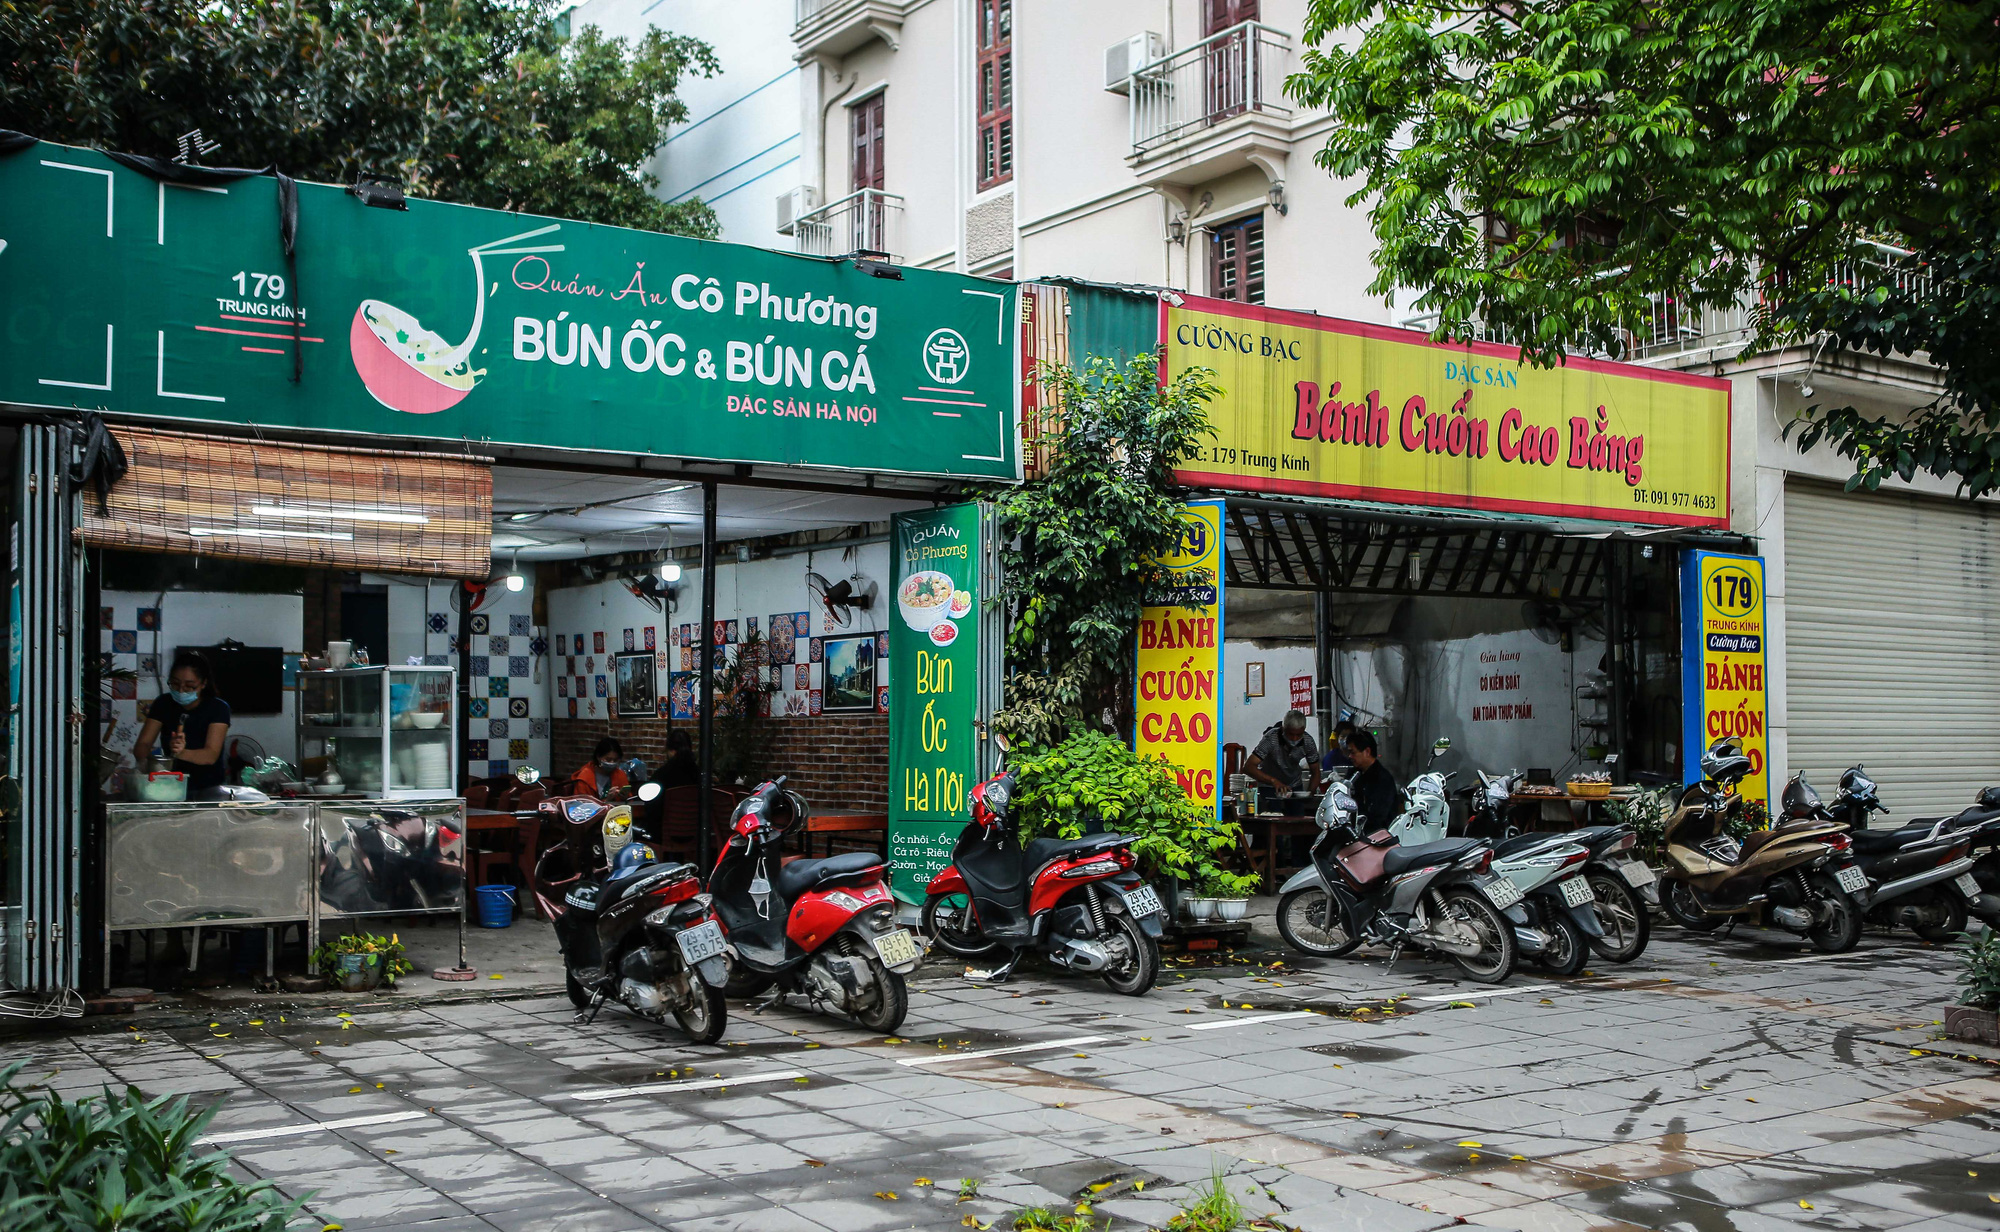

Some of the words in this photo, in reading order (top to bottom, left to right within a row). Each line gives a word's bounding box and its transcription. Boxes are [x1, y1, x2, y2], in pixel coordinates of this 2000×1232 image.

[232, 271, 285, 300] 179
[512, 255, 604, 297] Quán
[610, 262, 668, 307] Ăn
[670, 273, 724, 314] Cô
[734, 281, 878, 340] Phương
[216, 298, 268, 316] TRUNG
[271, 303, 306, 320] KÍNH
[513, 311, 611, 369] BÚN
[621, 319, 687, 377] ỐC
[693, 347, 718, 381] &
[725, 334, 812, 389] BÚN
[820, 344, 877, 395] CÁ
[1177, 323, 1254, 354] CƯỜNG
[1260, 335, 1302, 362] BẠC
[1444, 359, 1481, 386] ĐẶC
[1484, 362, 1518, 390] SẢN
[725, 394, 768, 417] ĐẶC
[772, 396, 811, 418] SẢN
[816, 399, 842, 421] HÀ
[846, 403, 878, 427] NỘI
[1291, 379, 1391, 449] Bánh
[1399, 388, 1490, 462] Cuốn
[1498, 406, 1560, 470] Cao
[1567, 403, 1646, 488] Bằng
[1212, 447, 1237, 464] 179
[1240, 449, 1277, 472] Trung
[1281, 453, 1310, 471] Kính
[1634, 488, 1649, 504] ĐT:
[1650, 490, 1668, 506] 091
[1672, 492, 1690, 507] 977
[1692, 494, 1716, 510] 4633
[912, 524, 960, 544] QUÁN
[905, 548, 919, 562] Cô
[921, 544, 968, 559] Phương
[1712, 574, 1752, 609] 179
[1140, 610, 1215, 649] BÁNH
[1707, 619, 1737, 632] TRUNG
[1739, 620, 1760, 632] KÍNH
[1710, 634, 1738, 651] Cường
[1740, 636, 1758, 651] Bạc
[916, 650, 953, 695] Bún
[1140, 656, 1215, 702] CUỐN
[1480, 673, 1489, 691] CÓ
[1505, 671, 1521, 691] SOÁT
[1705, 655, 1763, 692] BÁNH
[1473, 706, 1481, 721] AN
[1481, 702, 1498, 721] TOÀN
[1706, 697, 1764, 739] CUỐN
[921, 698, 948, 754] Ốc
[1140, 712, 1213, 743] CAO
[1146, 752, 1215, 800] NG
[905, 767, 929, 813] Hà
[935, 767, 964, 817] Nội
[892, 831, 906, 844] Ốc
[938, 832, 952, 845] Ốc
[909, 847, 920, 857] rô
[890, 860, 917, 870] Sườn
[926, 860, 947, 872] Mọc
[1127, 887, 1152, 905] 29-K1
[1131, 898, 1160, 917] 536.55
[687, 937, 724, 961] 159.75
[880, 933, 908, 951] 29-F1
[883, 945, 917, 965] 343.34
